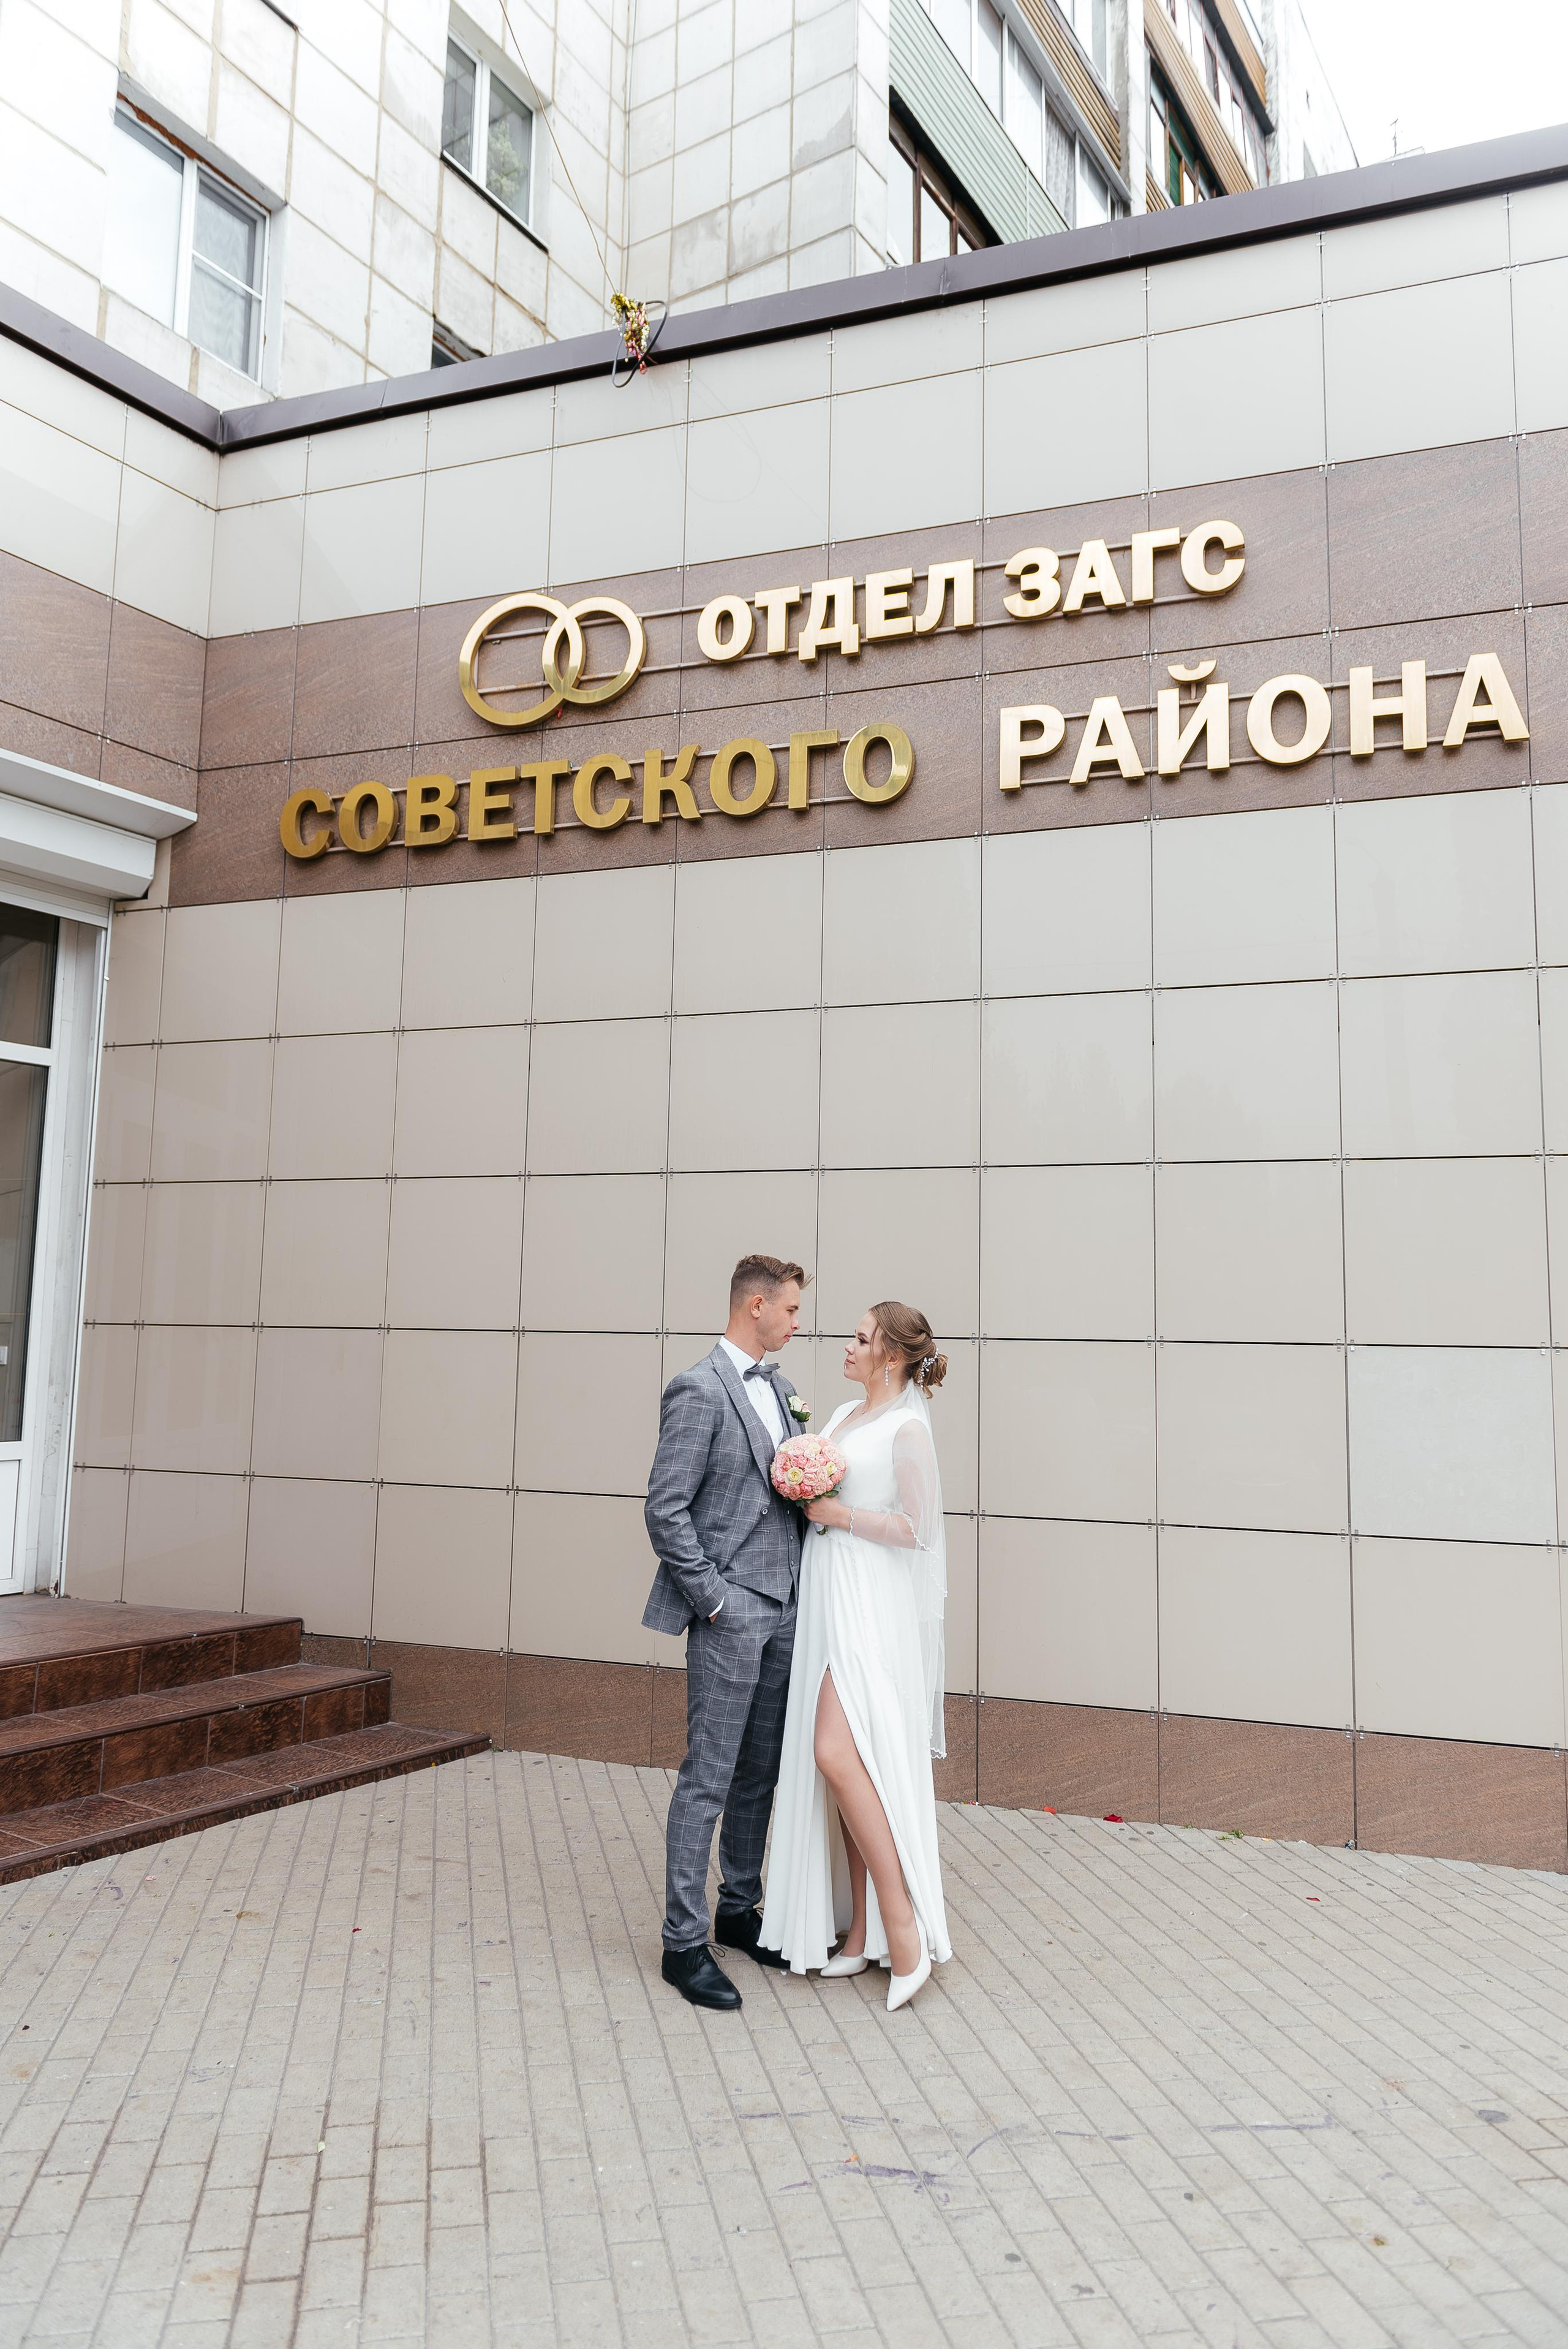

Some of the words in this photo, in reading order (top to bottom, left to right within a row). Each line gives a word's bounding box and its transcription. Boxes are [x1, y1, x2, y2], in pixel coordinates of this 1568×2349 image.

[697, 558, 975, 664] ОТДЕЛ
[1003, 520, 1246, 619] ЗАГС
[279, 722, 915, 858] СОВЕТСКОГО
[999, 652, 1529, 793] РАЙОНА
